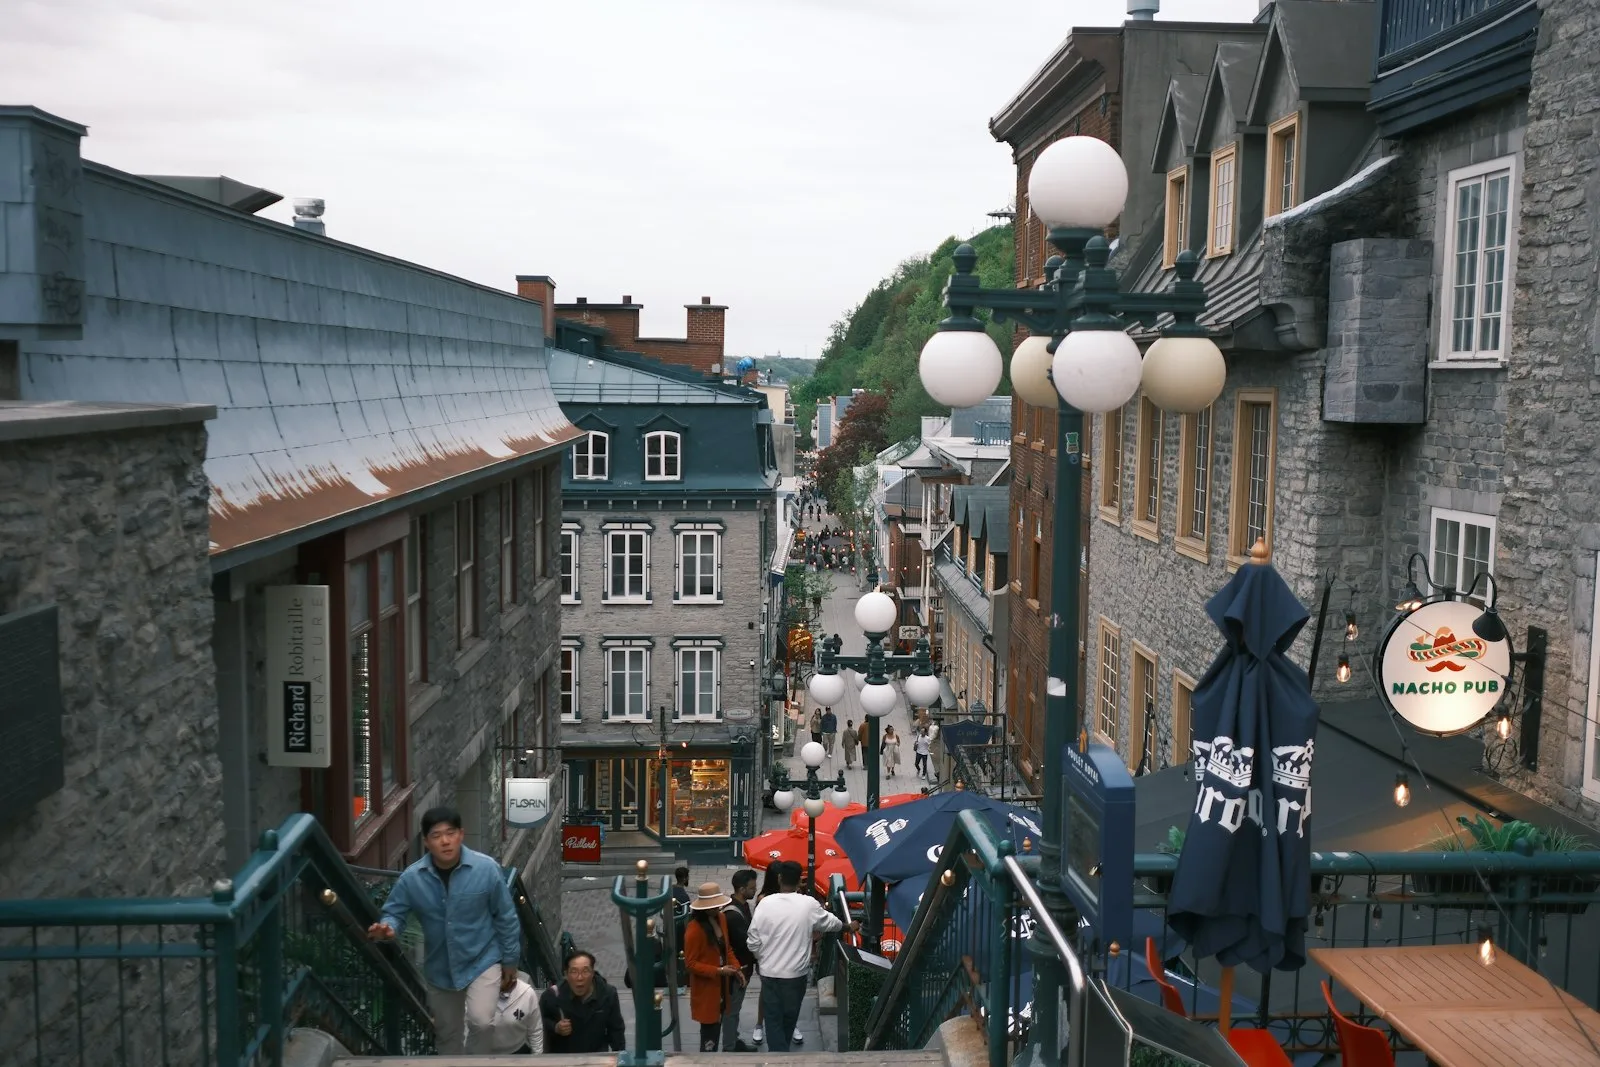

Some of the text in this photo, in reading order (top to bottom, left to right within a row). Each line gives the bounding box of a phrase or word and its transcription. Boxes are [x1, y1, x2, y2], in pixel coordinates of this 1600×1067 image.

[288, 597, 306, 748] Richard Robitaille
[312, 597, 325, 755] SIGNATURE
[1392, 679, 1499, 695] NACHO PUB
[509, 798, 546, 808] FLORIN
